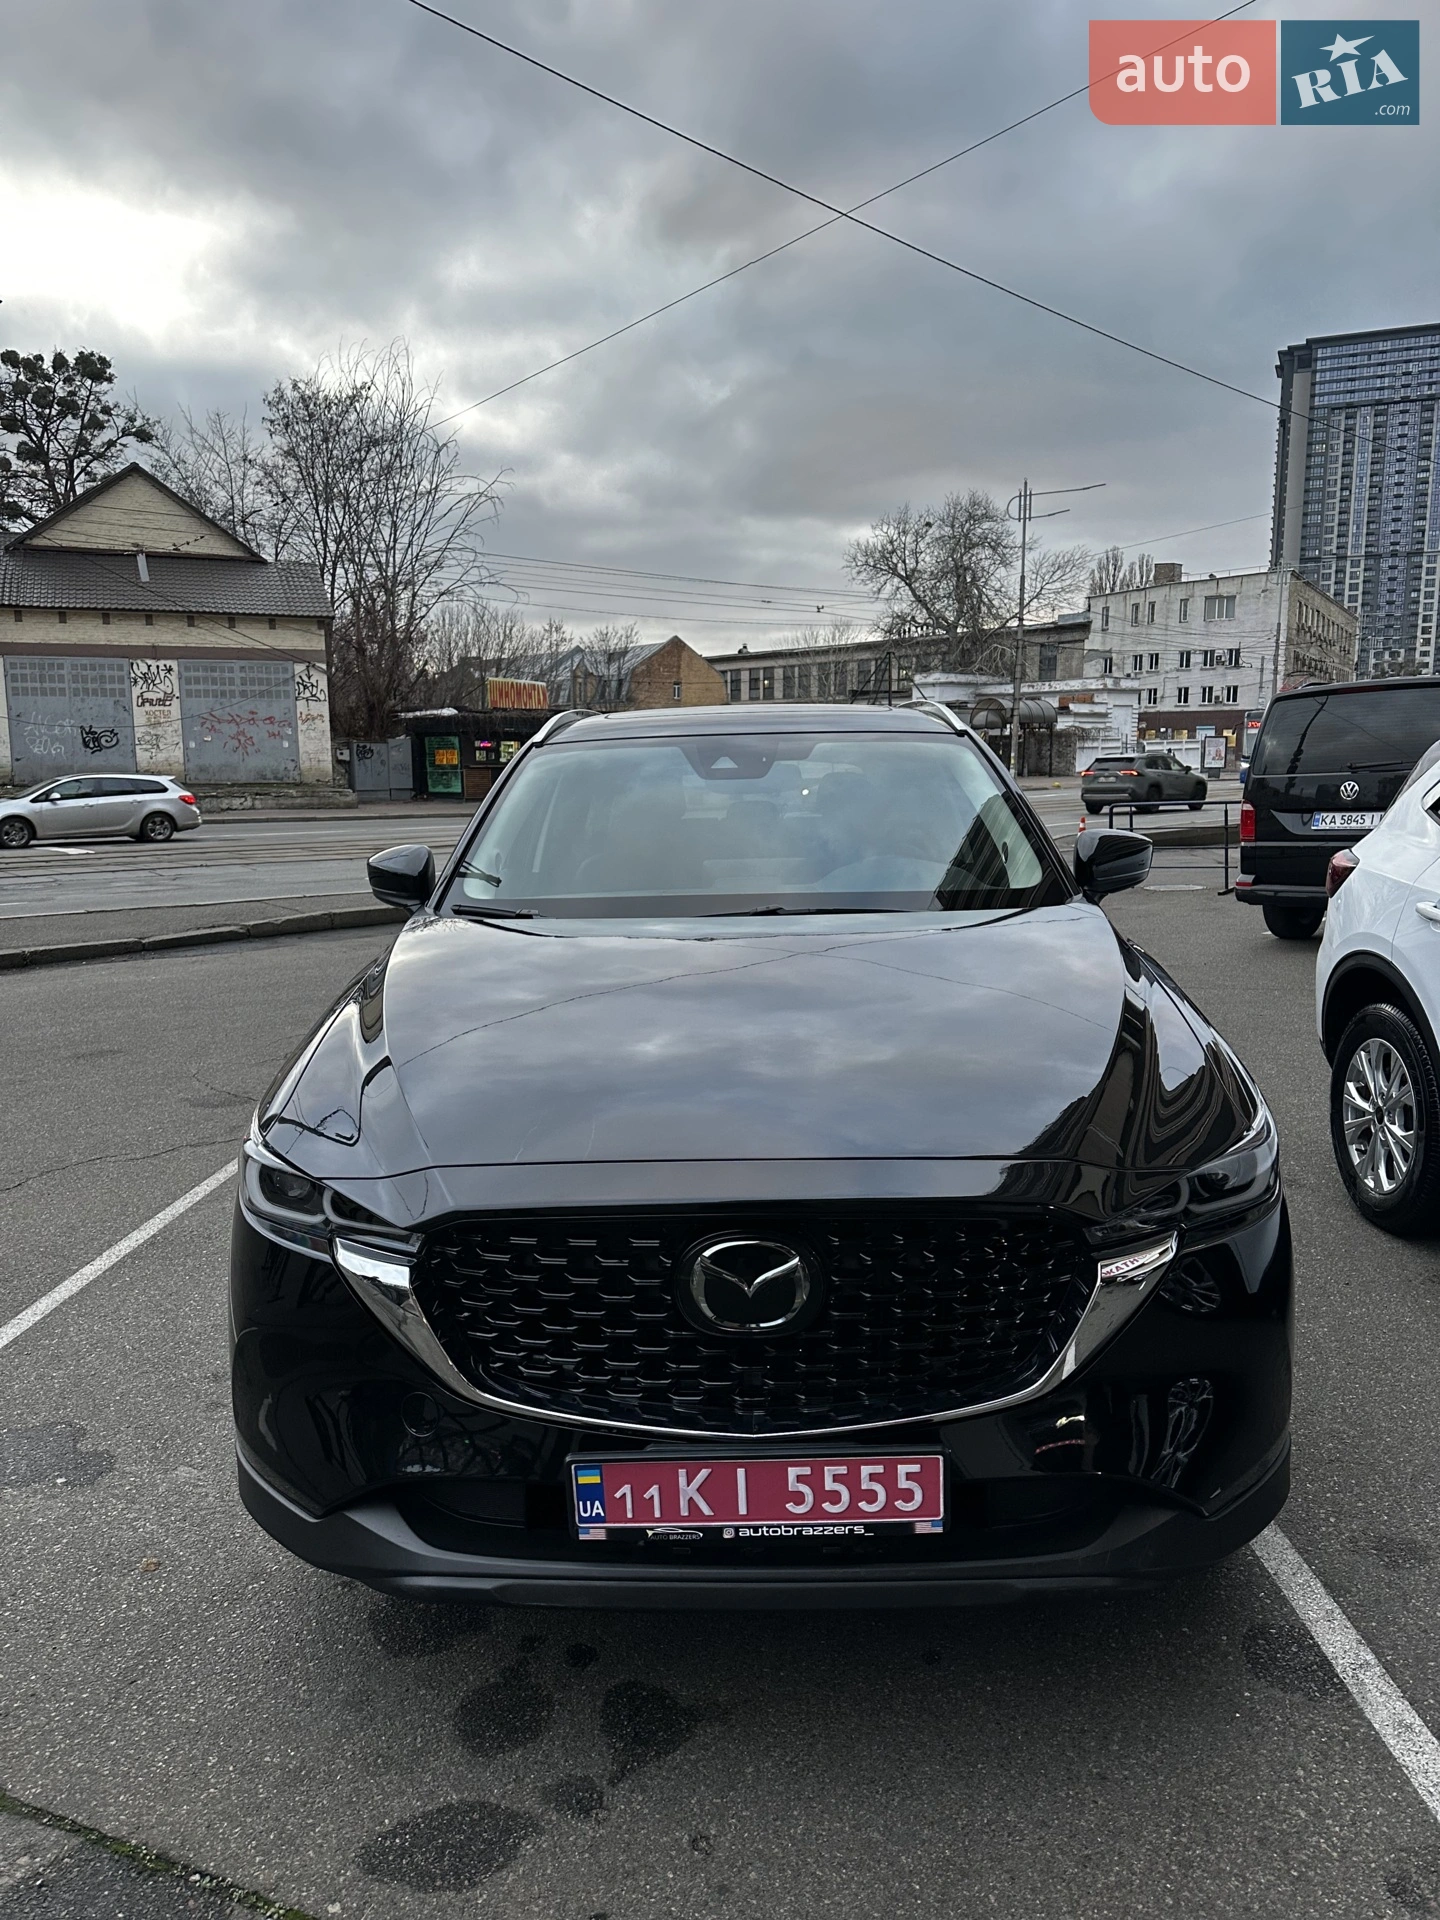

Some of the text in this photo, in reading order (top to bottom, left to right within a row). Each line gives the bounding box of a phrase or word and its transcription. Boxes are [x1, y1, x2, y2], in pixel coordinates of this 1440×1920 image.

[1320, 814, 1337, 826] KA
[1340, 814, 1366, 825] 5845
[785, 1464, 923, 1514] 5555
[579, 1500, 605, 1517] UA
